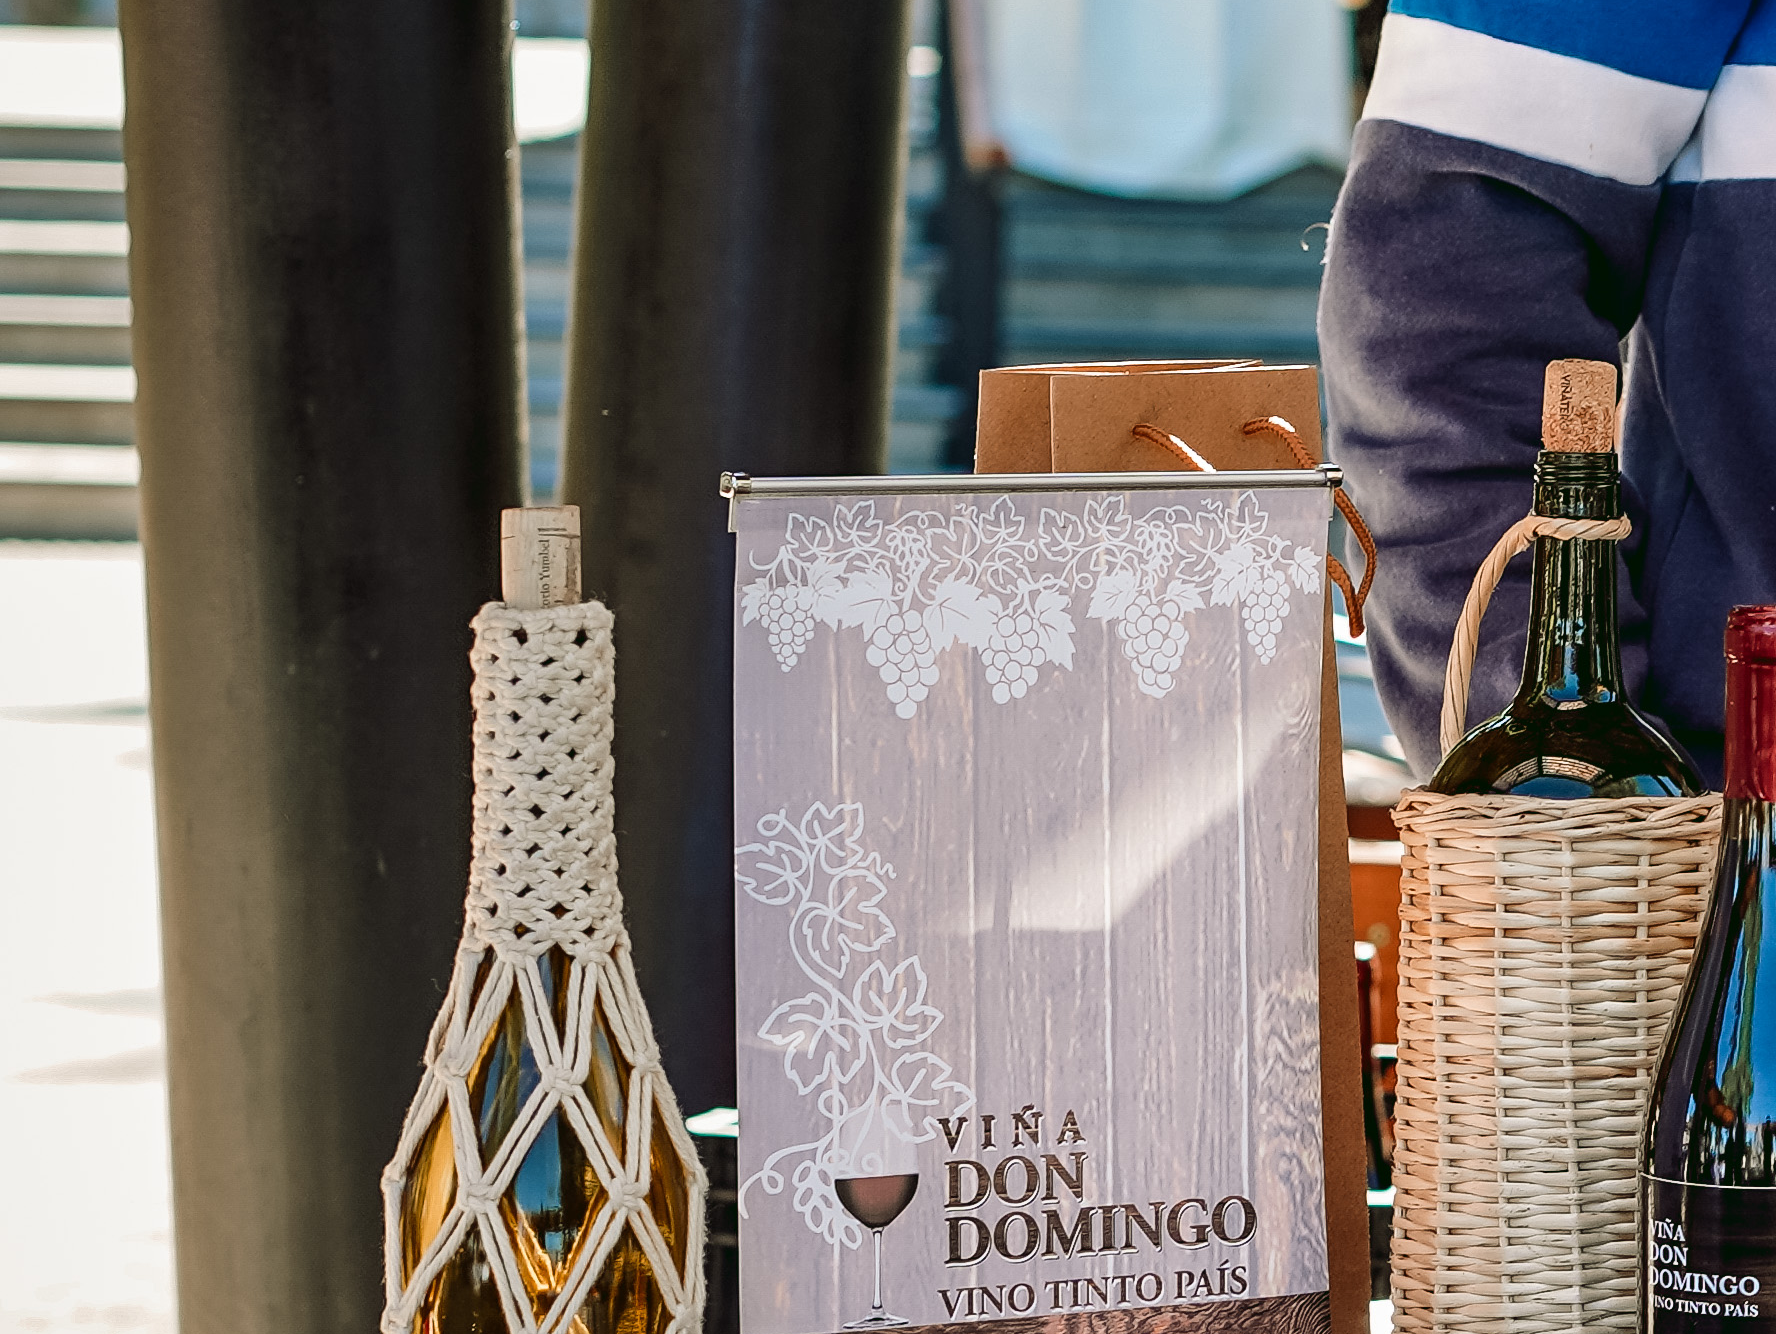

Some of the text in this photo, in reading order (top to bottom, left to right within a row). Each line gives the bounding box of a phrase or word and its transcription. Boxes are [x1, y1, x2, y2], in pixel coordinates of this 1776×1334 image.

[537, 539, 551, 581] Yumbel
[937, 1104, 1087, 1153] VIÑA
[944, 1152, 1088, 1211] DON
[944, 1195, 1257, 1267] DOMINGO
[1649, 1241, 1689, 1266] DON
[937, 1259, 1249, 1320] VINO TINTO PAÍS
[1649, 1265, 1760, 1296] DOMINGO
[1651, 1295, 1759, 1317] INO TINTO PAÍS
